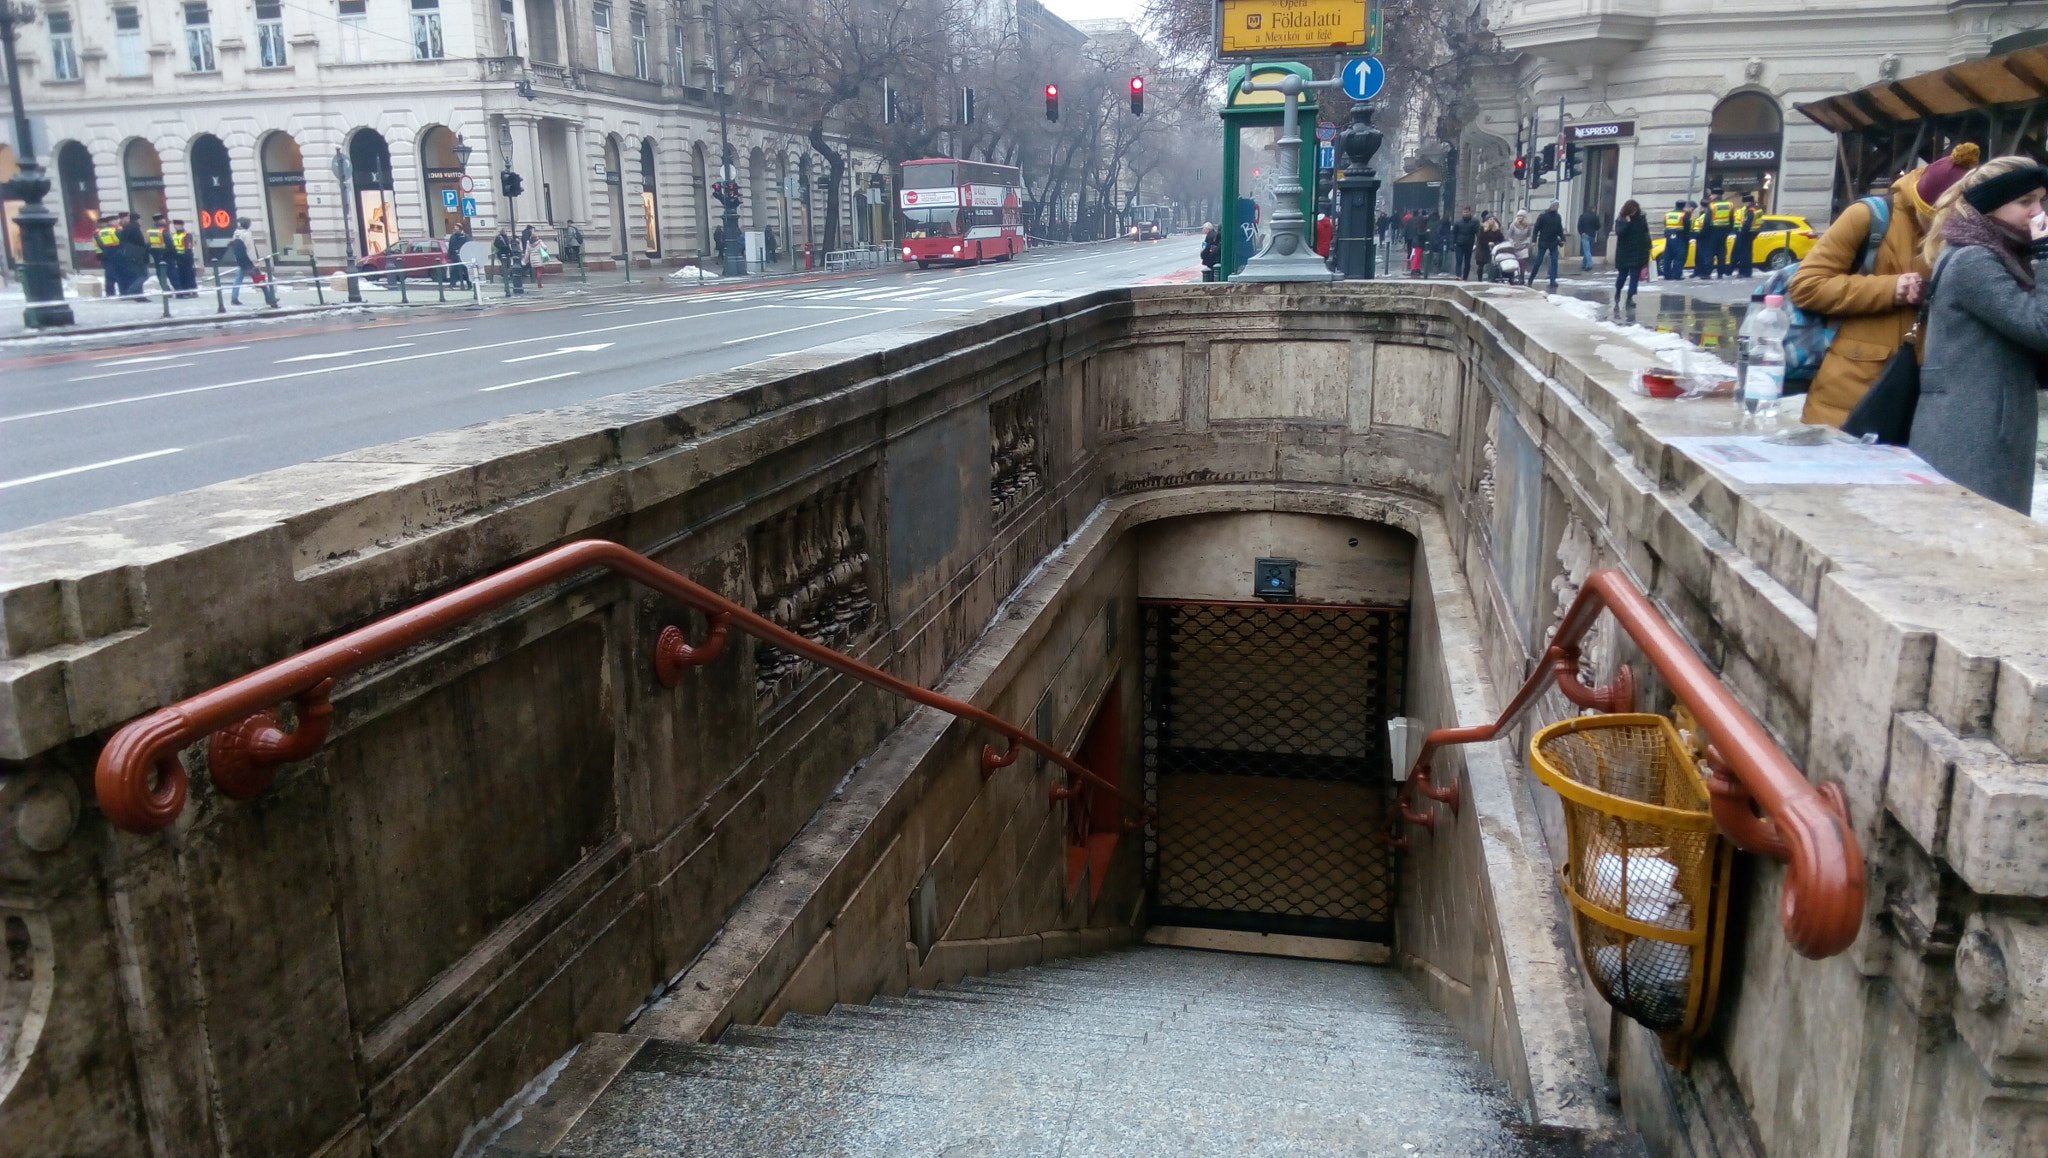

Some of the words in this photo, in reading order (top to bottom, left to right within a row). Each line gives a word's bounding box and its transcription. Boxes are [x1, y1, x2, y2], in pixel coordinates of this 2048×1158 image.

[1271, 9, 1341, 29] Földalatti
[1265, 30, 1300, 42] Mexikói
[1574, 126, 1619, 138] NESPRESSO
[1712, 150, 1775, 161] NESPRESSO
[446, 192, 455, 204] P
